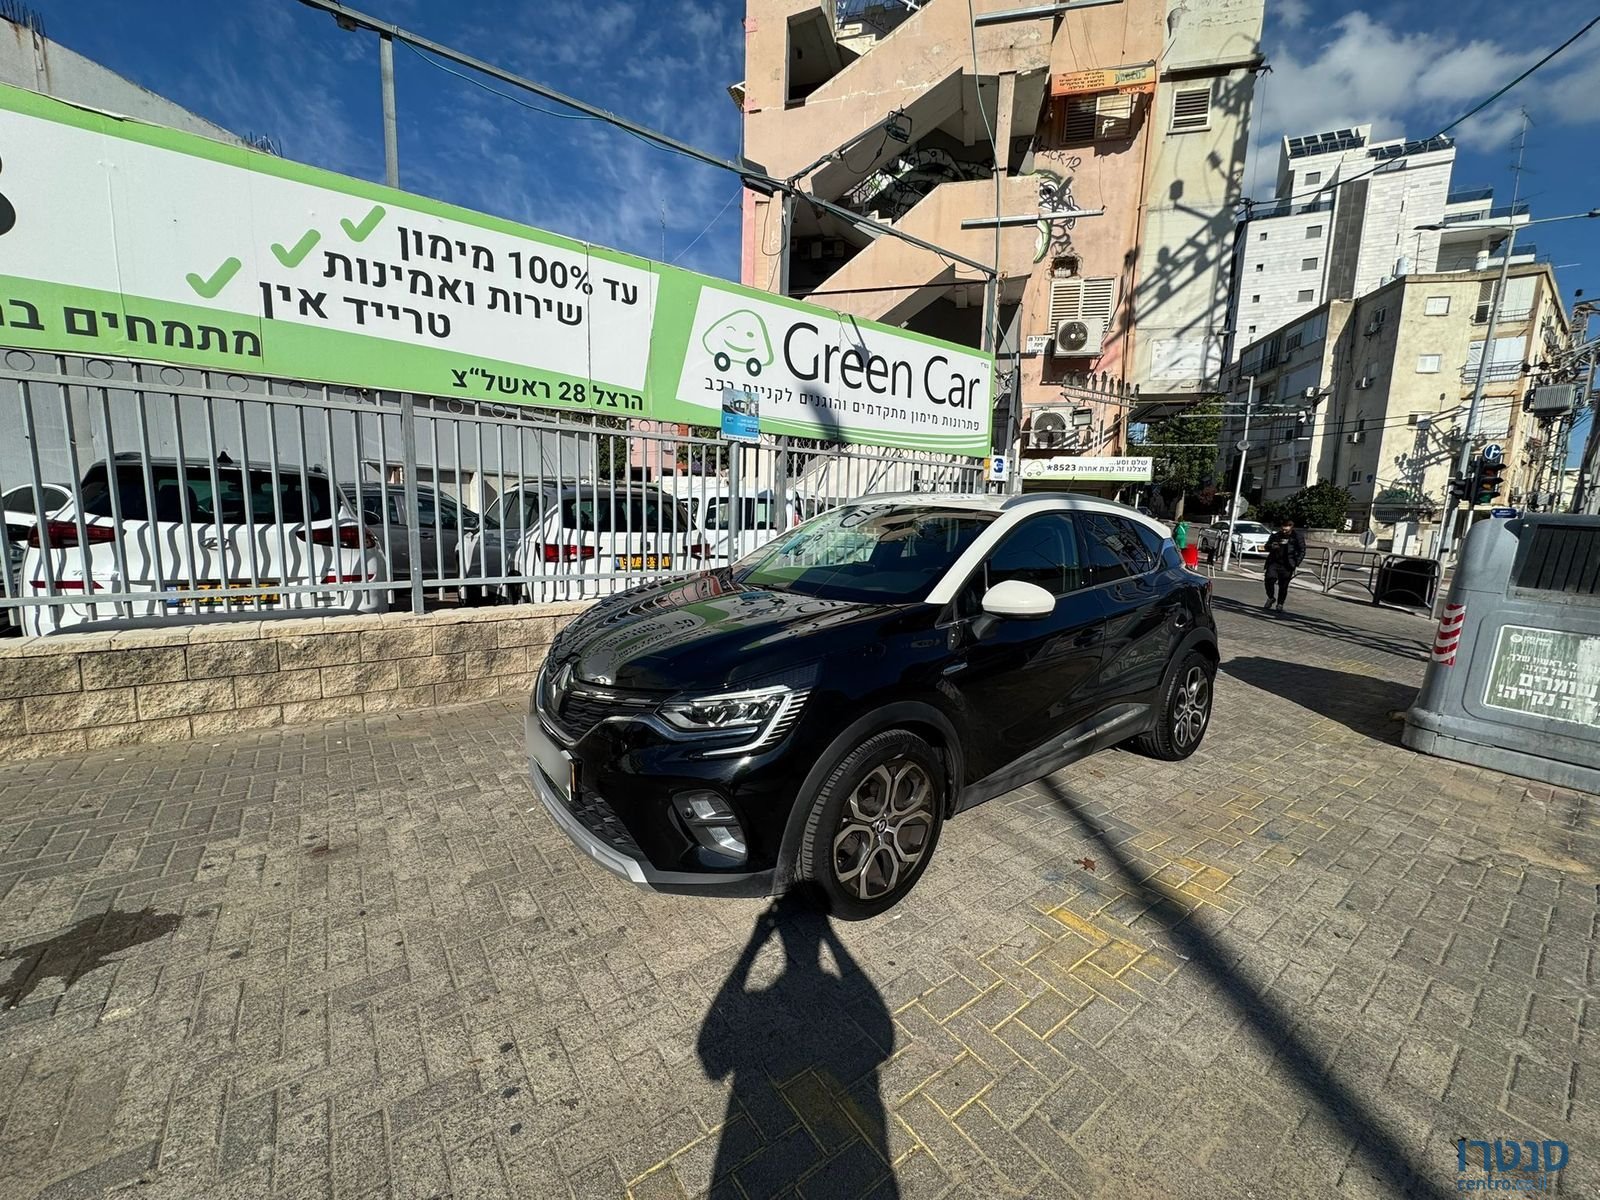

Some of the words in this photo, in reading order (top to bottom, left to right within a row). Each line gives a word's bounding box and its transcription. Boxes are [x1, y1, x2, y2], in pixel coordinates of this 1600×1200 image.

[397, 226, 495, 273] מימון
[323, 250, 475, 306] ואמינות
[508, 251, 593, 295] 100%
[259, 281, 329, 320] אין
[602, 277, 638, 305] עד
[343, 296, 451, 339] טרייד
[487, 285, 583, 326] שירות
[64, 306, 262, 358] מתמחים
[783, 321, 913, 399] Green
[923, 355, 981, 410] Car
[558, 381, 586, 403] 28
[592, 385, 643, 411] הרצל
[799, 393, 847, 411] והוגנים
[853, 402, 906, 420] מתקדמים
[911, 411, 938, 424] מימון
[942, 416, 980, 431] פתרונות
[1533, 657, 1562, 668] ראשון
[1497, 684, 1557, 707] נקייה!
[1519, 673, 1598, 698] שומרים
